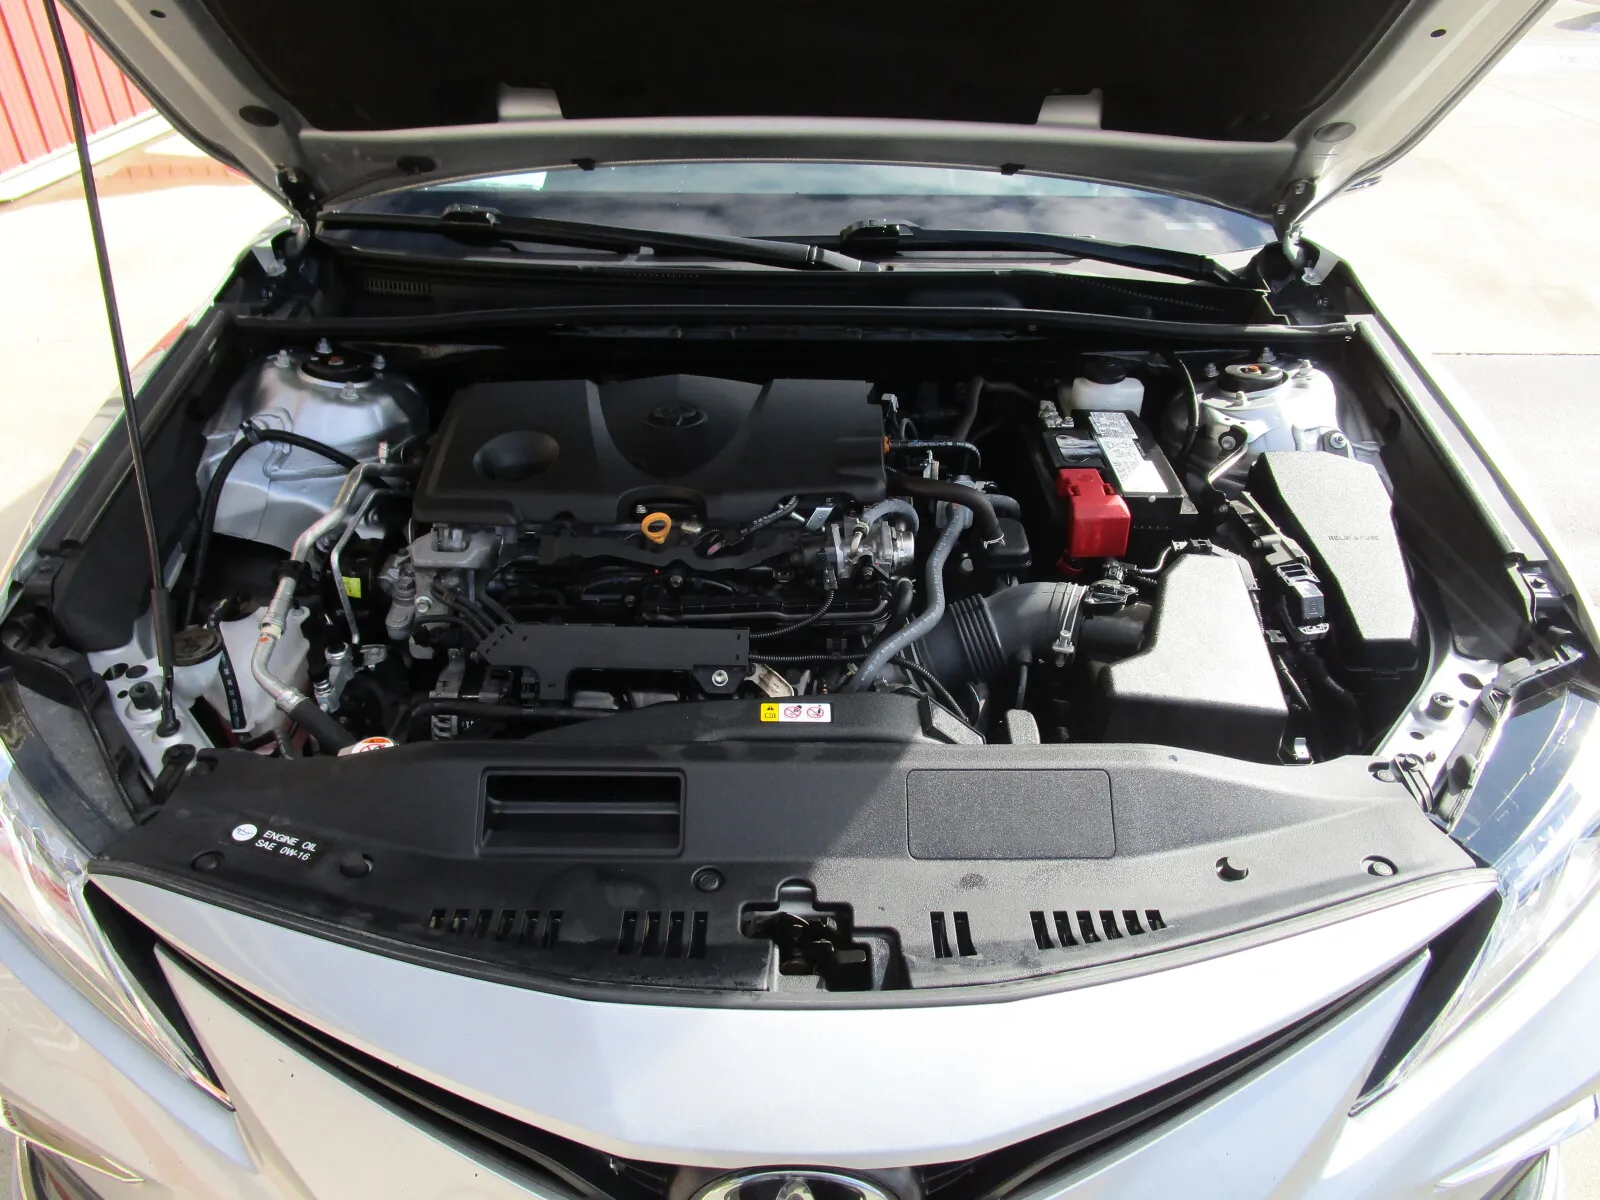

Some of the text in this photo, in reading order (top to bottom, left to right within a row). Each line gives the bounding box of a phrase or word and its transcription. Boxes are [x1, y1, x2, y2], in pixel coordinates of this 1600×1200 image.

[255, 839, 311, 861] SAE 0W-16
[263, 830, 317, 852] ENGINE OIL
